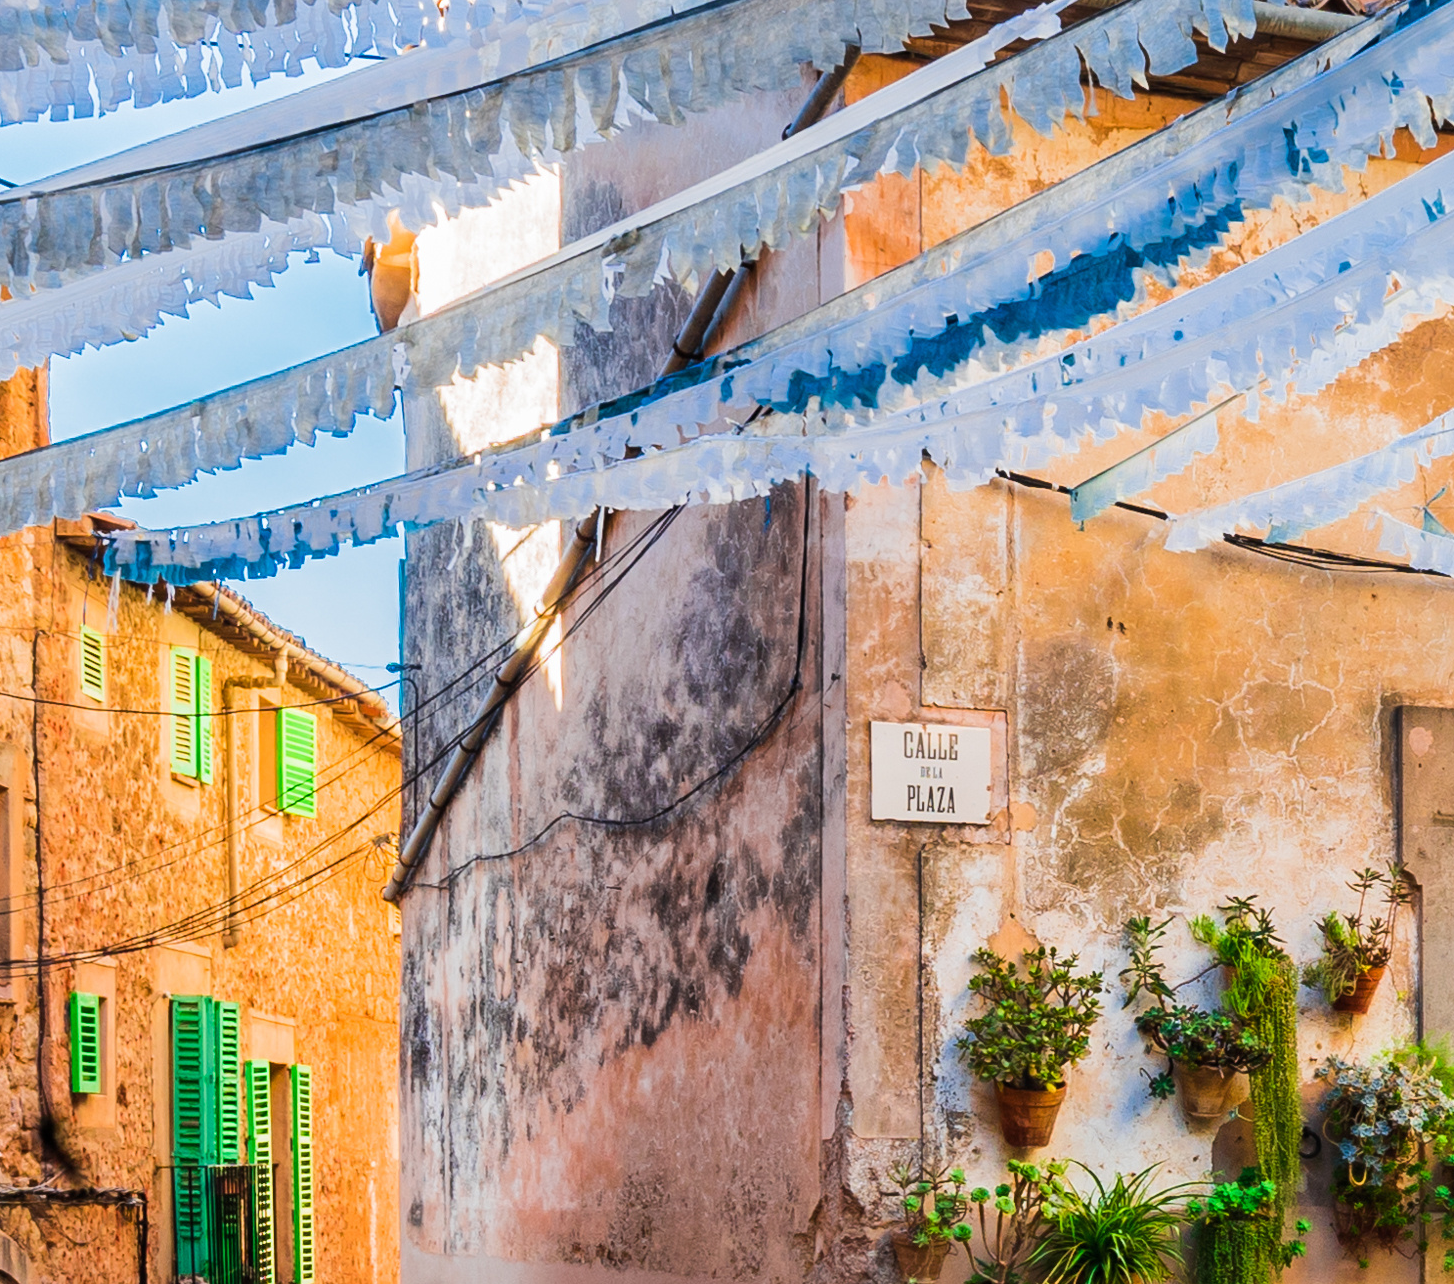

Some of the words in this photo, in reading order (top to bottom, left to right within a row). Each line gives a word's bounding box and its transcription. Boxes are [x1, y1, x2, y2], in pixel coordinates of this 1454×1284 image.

[903, 730, 959, 761] CALLE
[920, 766, 931, 779] DE
[933, 767, 943, 779] LA
[906, 784, 956, 814] PLAZA
